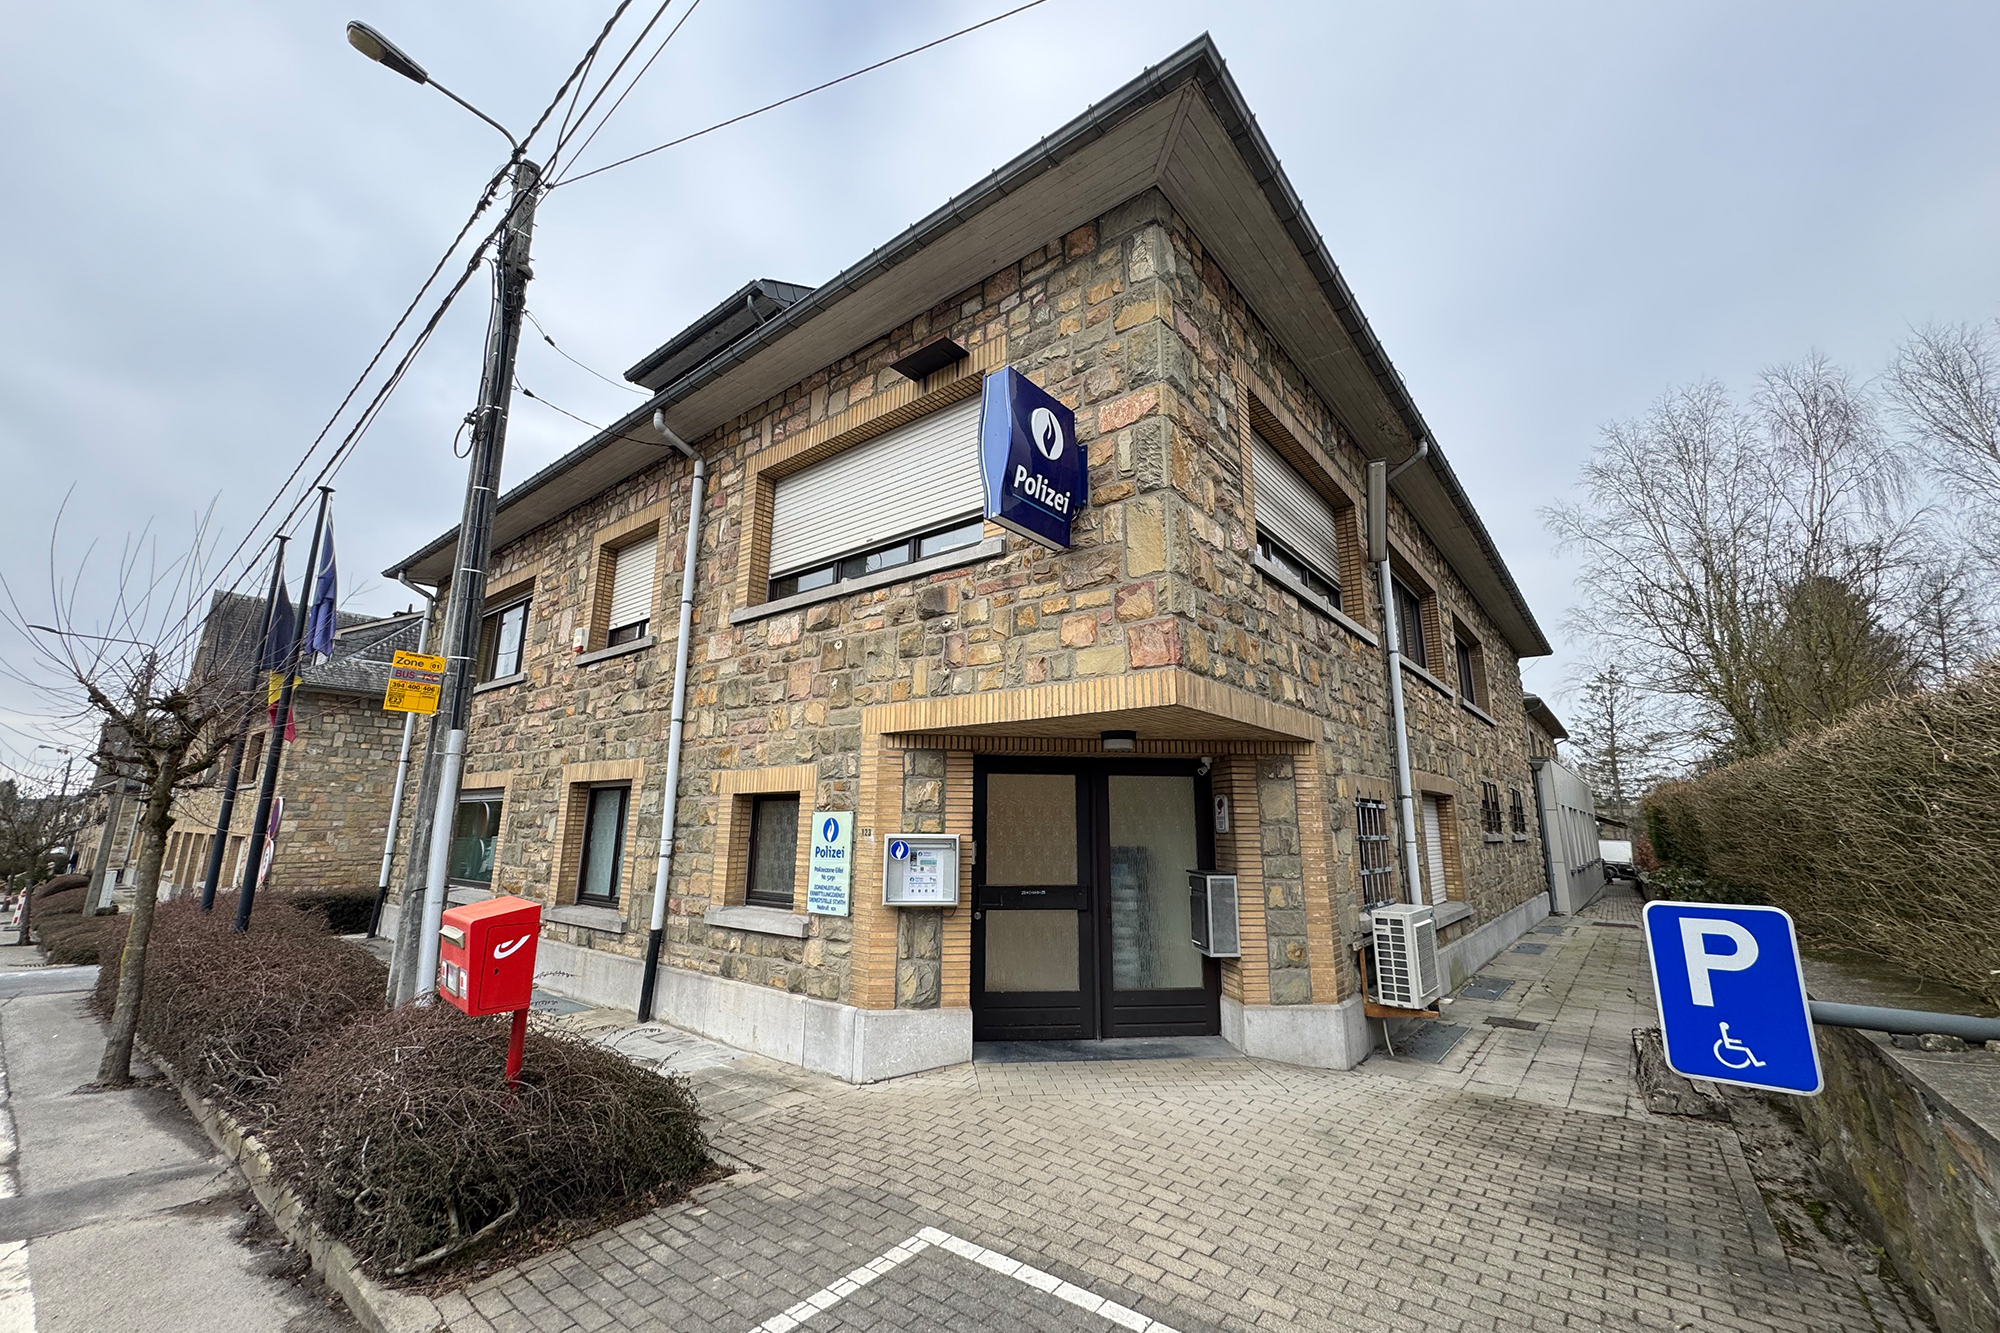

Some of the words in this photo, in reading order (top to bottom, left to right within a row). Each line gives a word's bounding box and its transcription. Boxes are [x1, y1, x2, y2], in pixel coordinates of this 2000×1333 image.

[1013, 464, 1071, 515] Polizei
[396, 656, 424, 667] Zone
[395, 669, 416, 679] BUS
[421, 673, 440, 682] TEC
[861, 828, 871, 836] 123
[815, 845, 845, 858] Polizei
[814, 866, 834, 874] Polizeizone
[1678, 917, 1759, 1007] P
